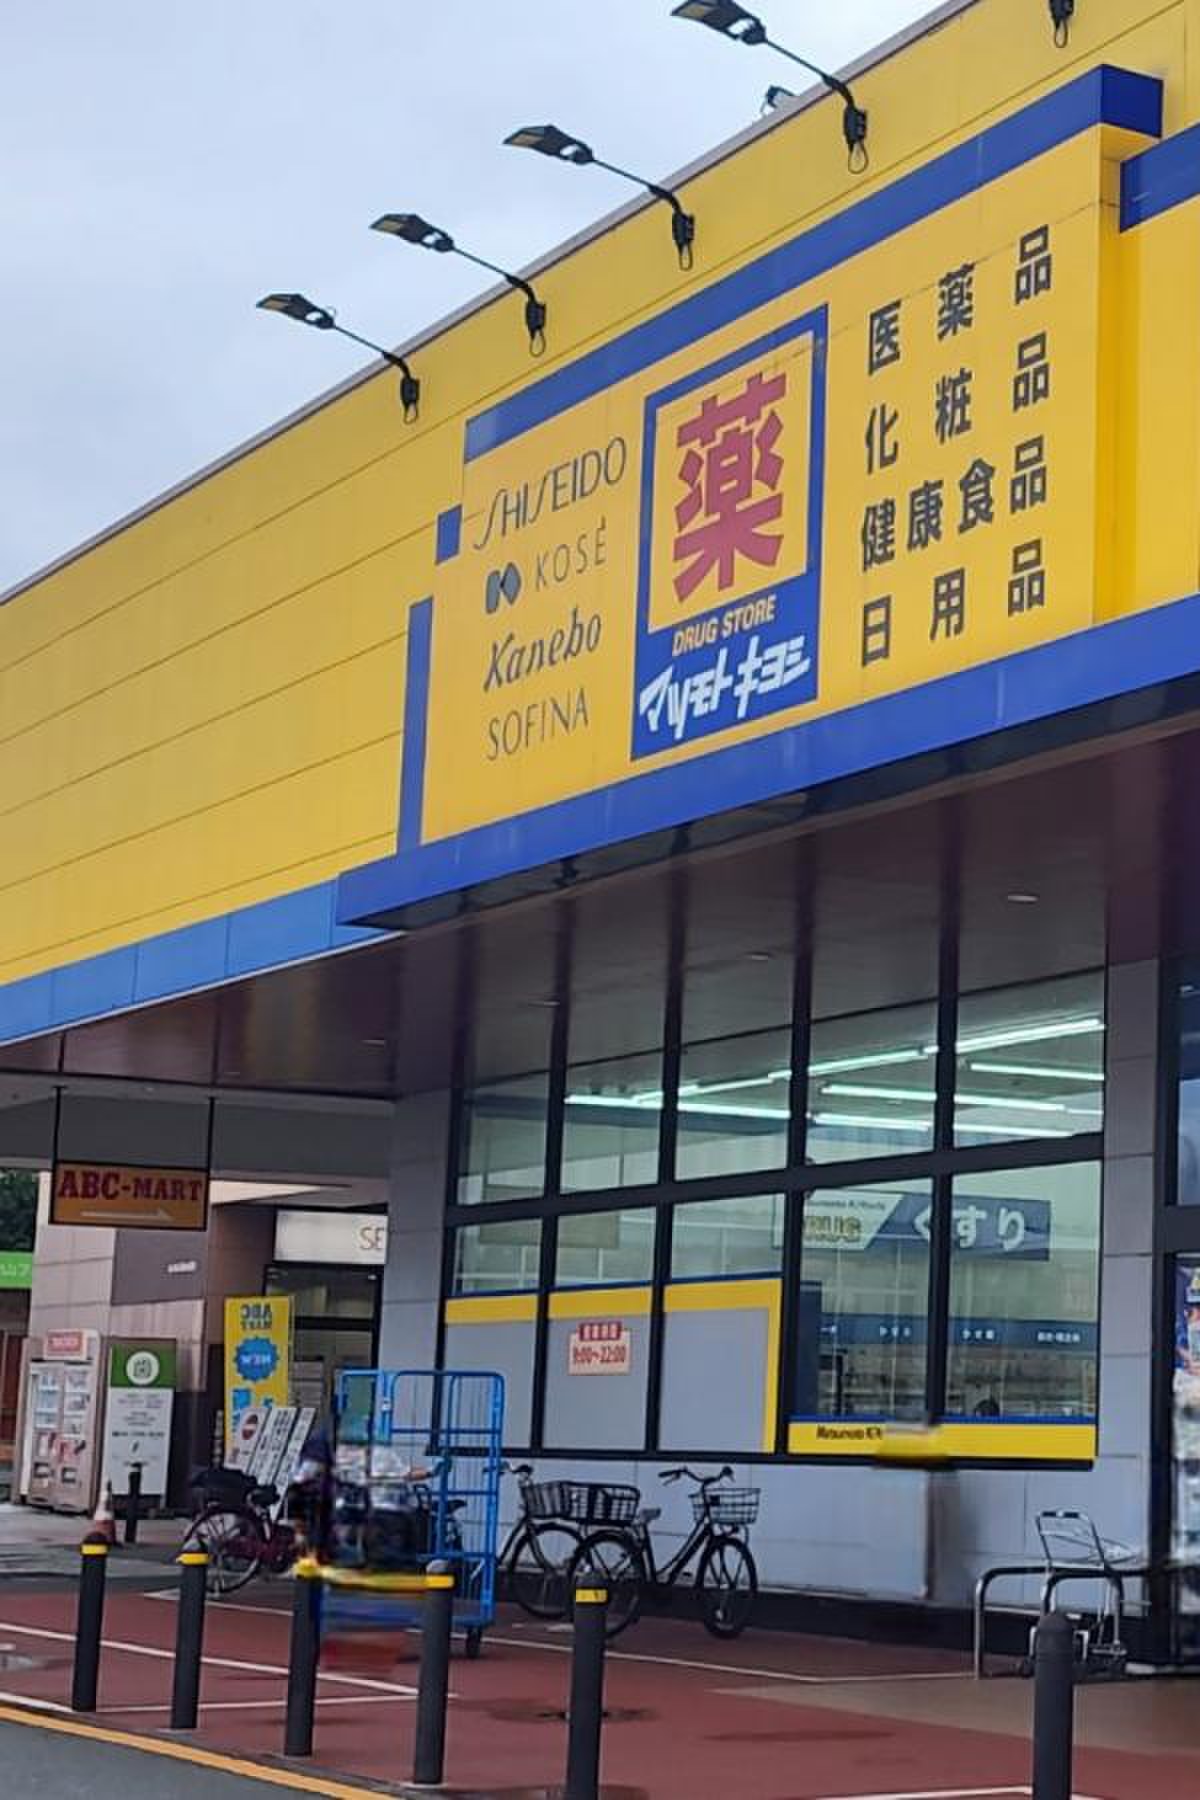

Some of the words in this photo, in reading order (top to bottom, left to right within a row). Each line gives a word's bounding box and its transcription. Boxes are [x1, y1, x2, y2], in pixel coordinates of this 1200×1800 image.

[867, 224, 1052, 376] 医薬品
[864, 331, 1051, 475] 化粧品
[473, 436, 627, 550] SHISEIDO
[672, 371, 788, 603] 薬
[861, 436, 1048, 572] 健康食品
[483, 604, 602, 693] Kanebo
[672, 617, 719, 657] DRUG
[722, 595, 775, 637] STORE
[861, 539, 1046, 668] 日用品
[487, 687, 589, 761] SOFINA
[640, 635, 810, 740] マツモトキヨシ
[56, 1168, 202, 1202] ABC-MART
